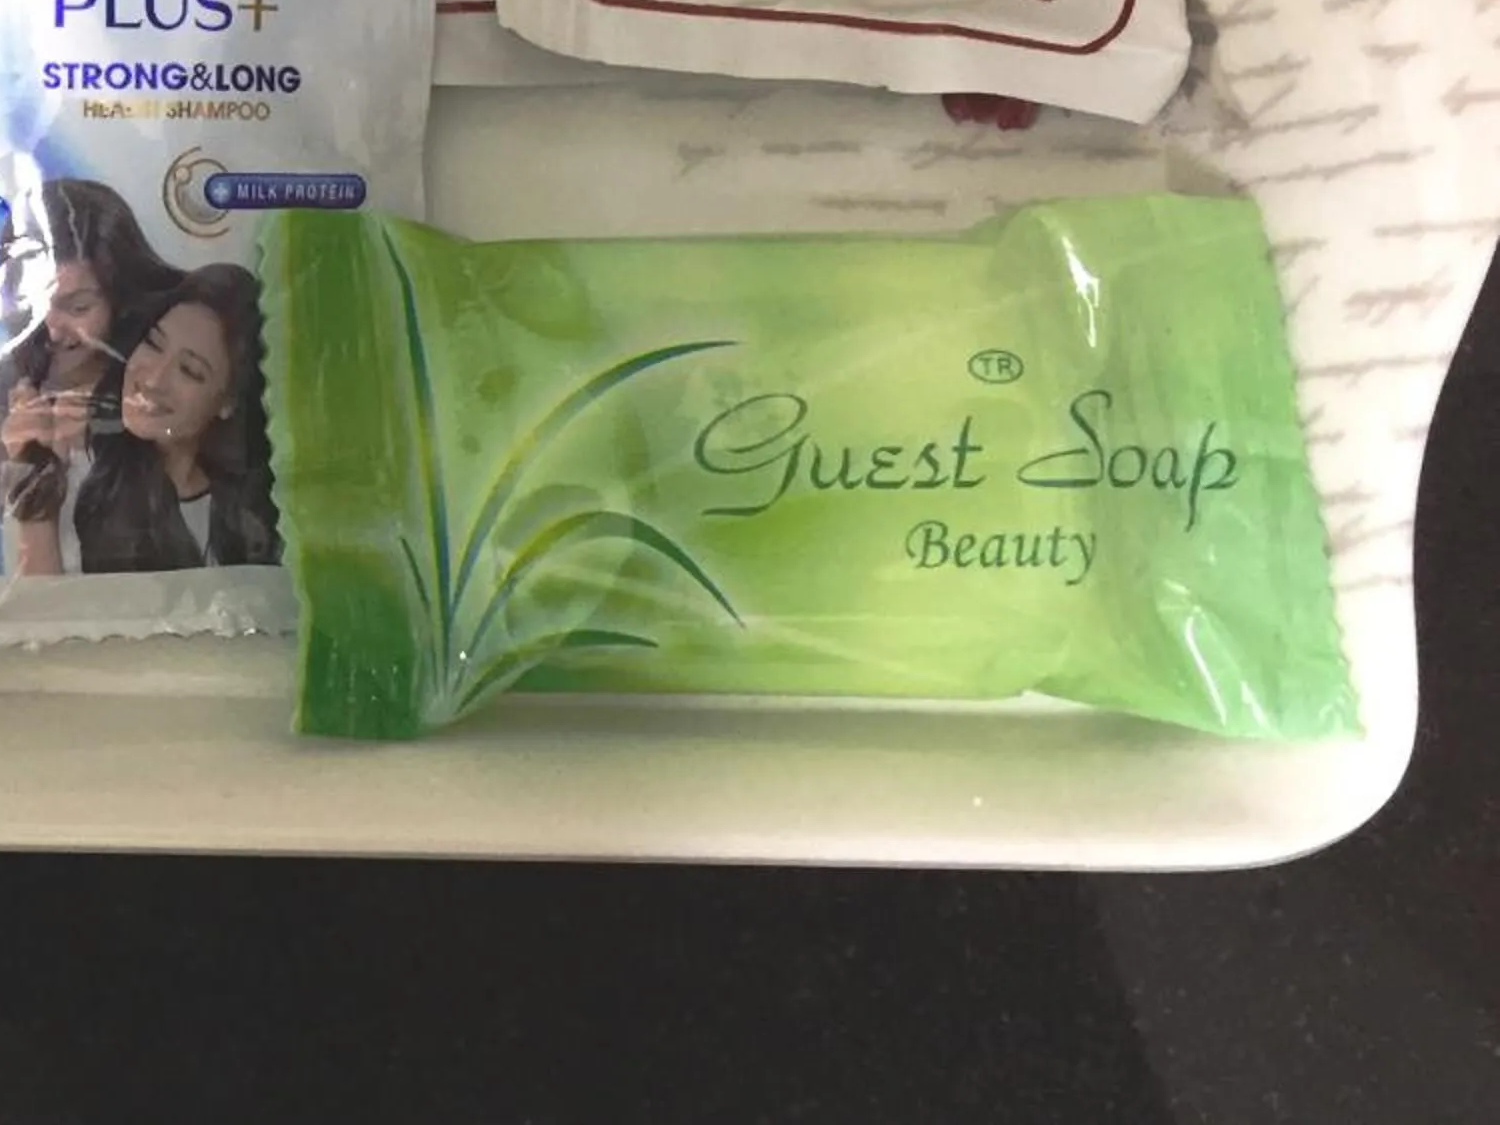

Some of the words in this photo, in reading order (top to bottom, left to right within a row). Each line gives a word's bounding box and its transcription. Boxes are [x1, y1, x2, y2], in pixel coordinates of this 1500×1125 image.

[236, 184, 278, 201] MILK
[284, 185, 356, 201] PROTEIN
[693, 393, 987, 517] Guest
[1017, 389, 1239, 533] Soap
[905, 520, 1097, 586] Beauty
